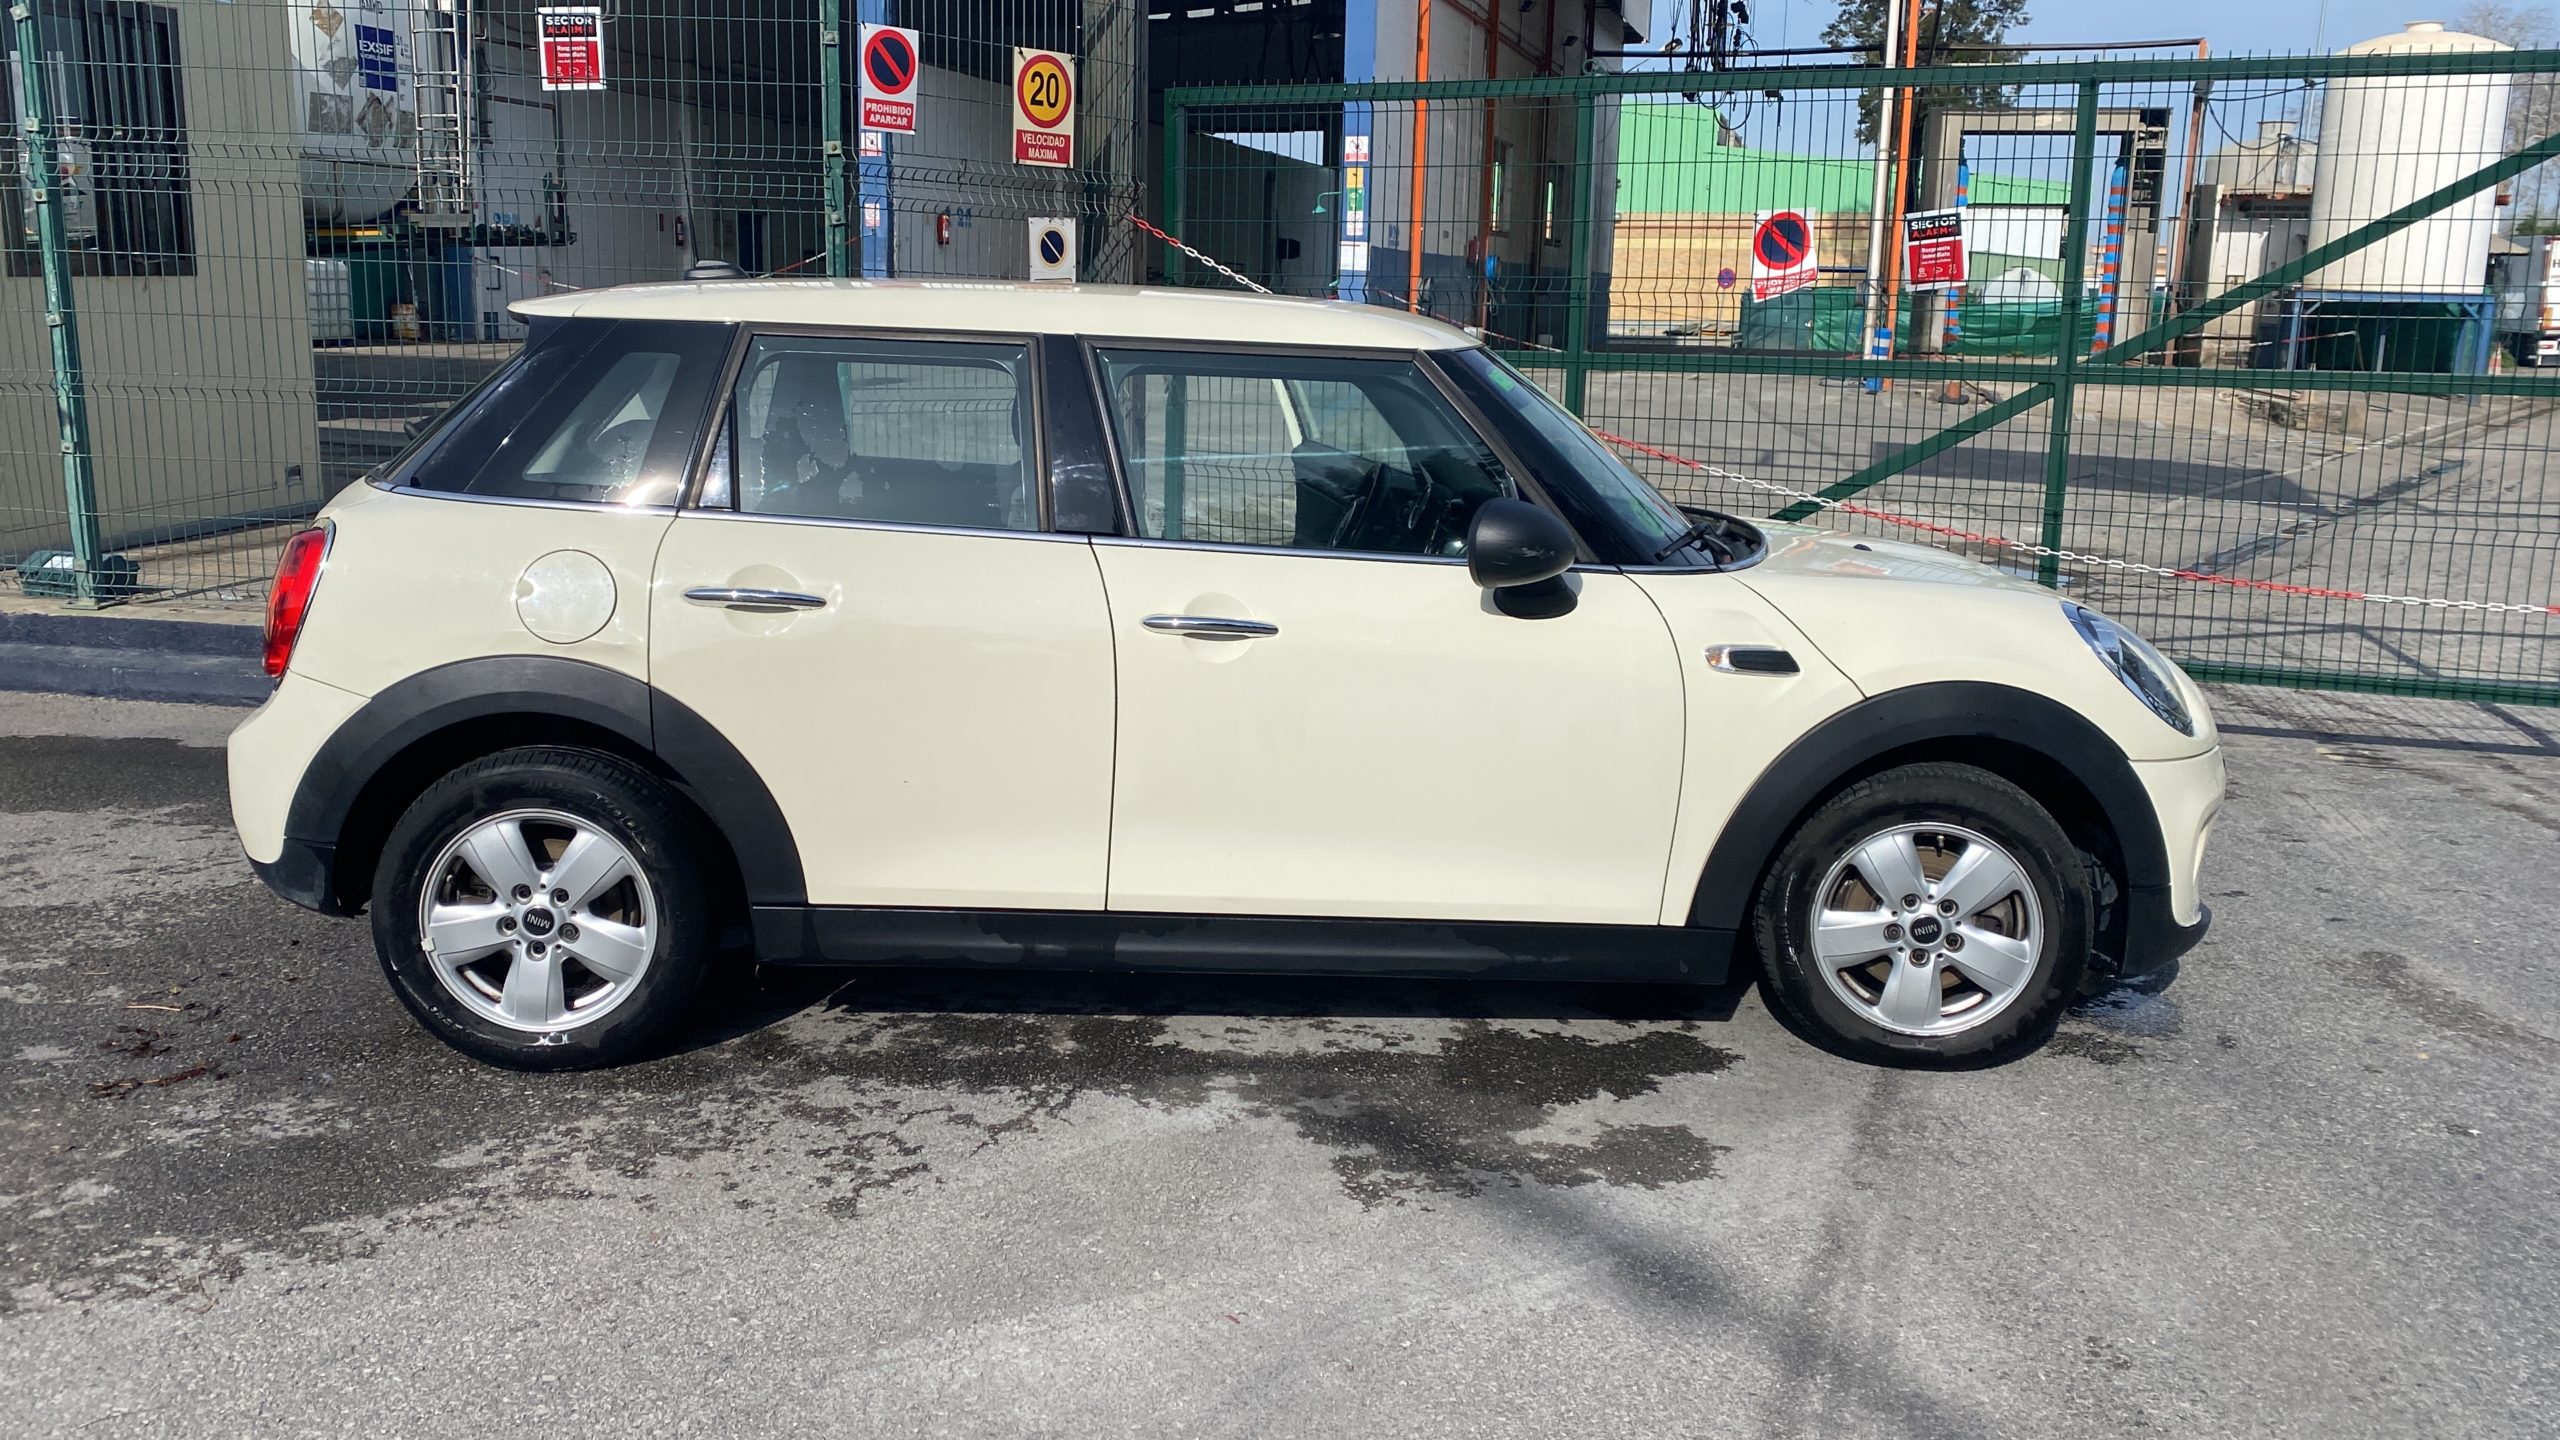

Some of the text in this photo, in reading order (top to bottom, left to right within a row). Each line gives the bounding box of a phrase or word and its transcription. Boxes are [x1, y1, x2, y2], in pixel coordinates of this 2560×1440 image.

[546, 16, 593, 25] SECTOR
[359, 40, 394, 56] EXSIF
[1030, 71, 1060, 109] 20
[866, 102, 912, 116] PROHIBIDO
[869, 113, 908, 126] APARCAR
[1022, 132, 1065, 148] VELOCIDAD
[1028, 144, 1058, 160] MÁXIMA
[1911, 216, 1957, 230] SECTOR
[527, 913, 550, 929] MINI
[1914, 923, 1938, 936] MINI
